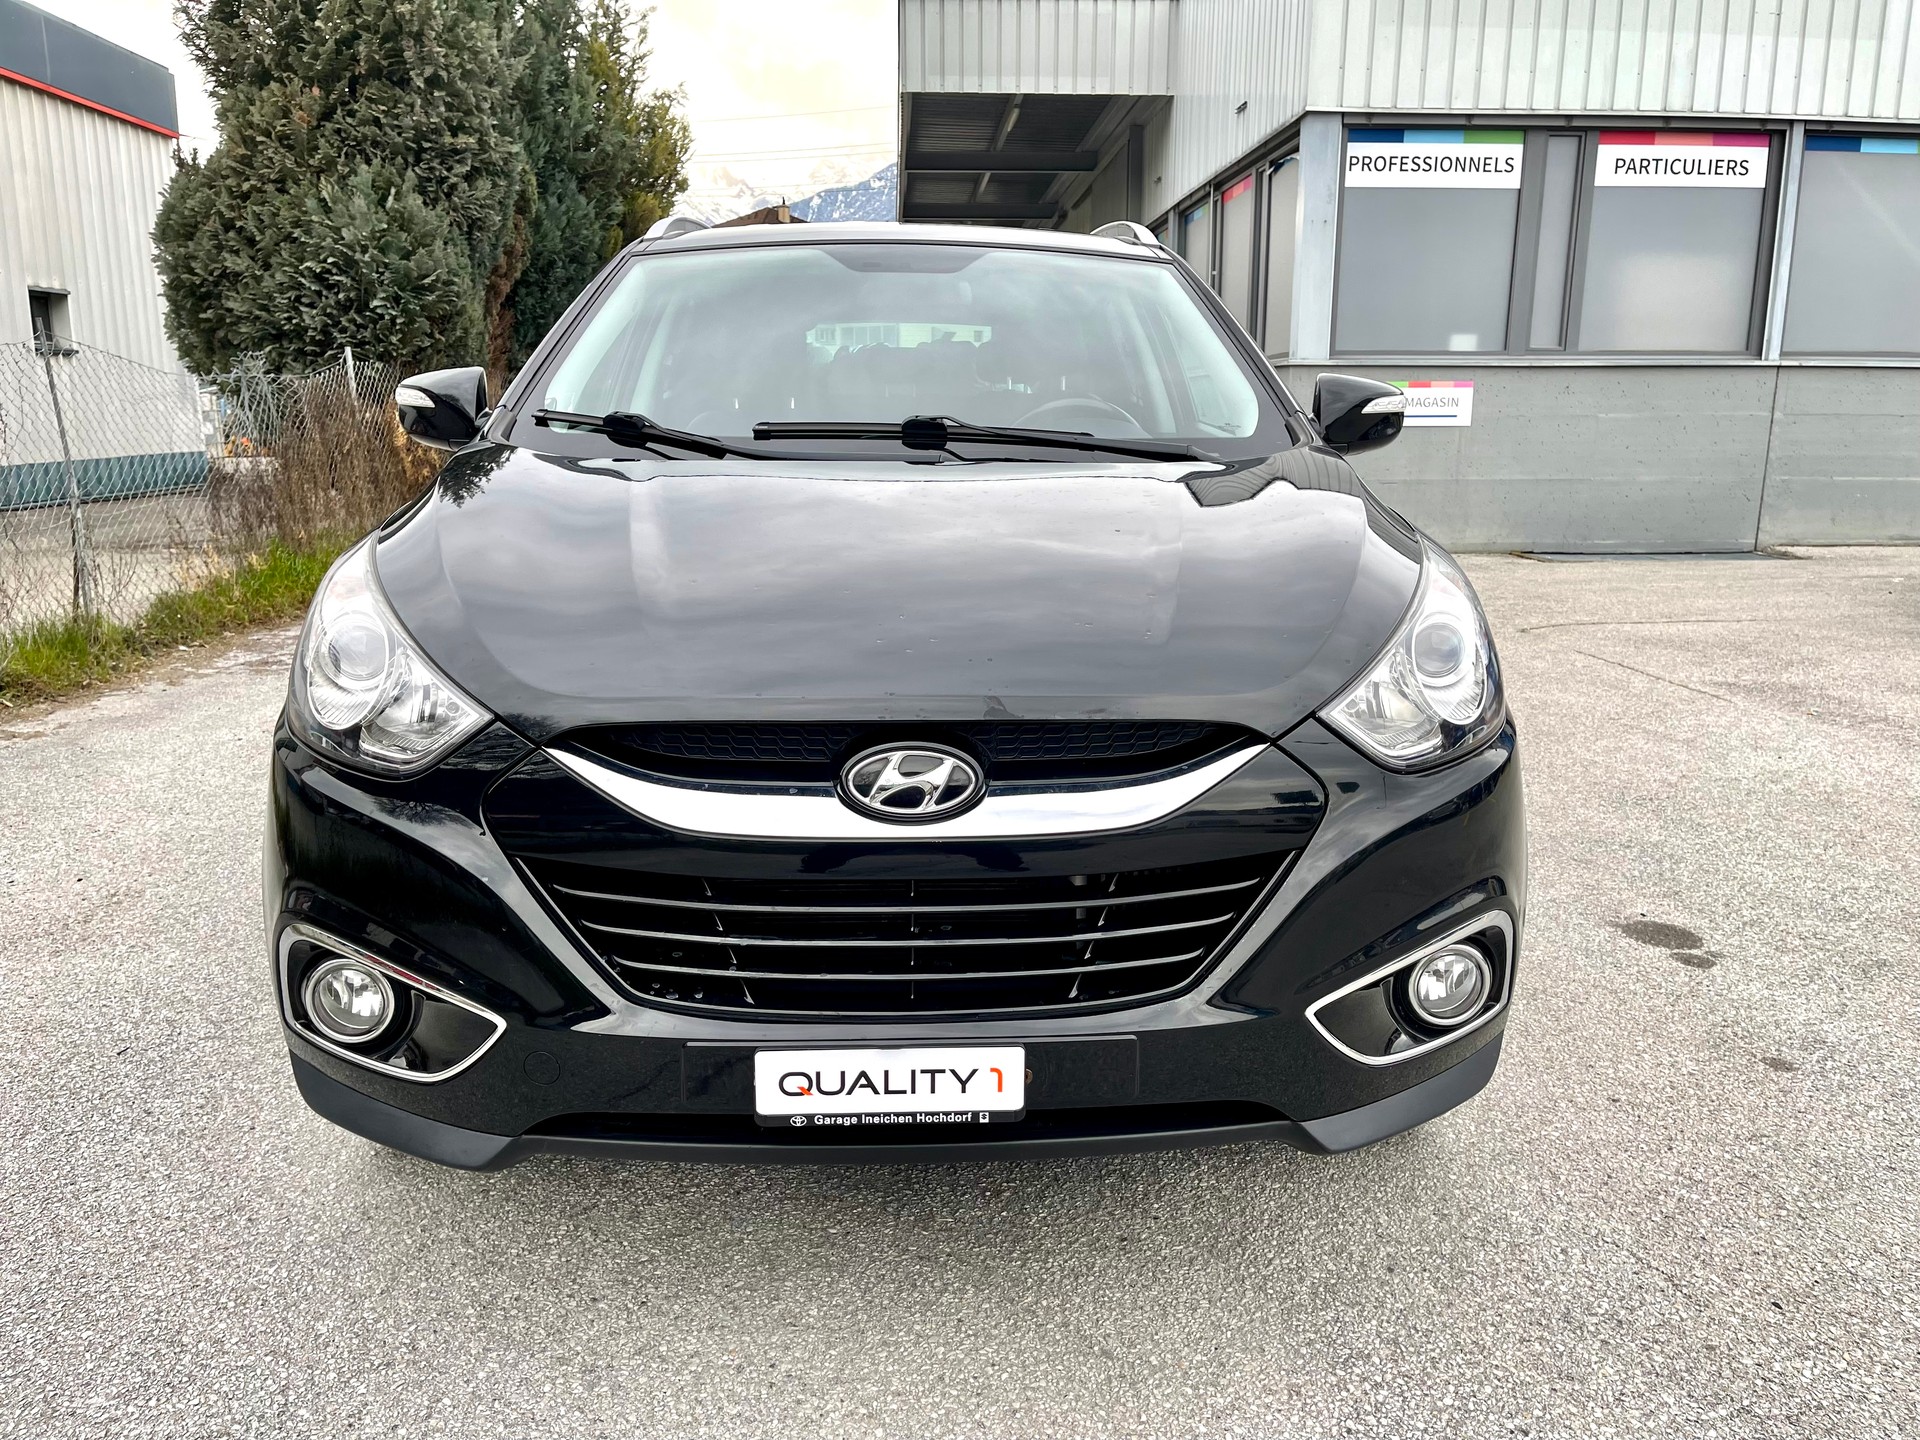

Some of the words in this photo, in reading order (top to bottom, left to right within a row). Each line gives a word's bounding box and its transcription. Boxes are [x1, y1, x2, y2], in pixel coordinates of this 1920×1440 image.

[1348, 155, 1515, 173] PROFESSIONNELS
[1614, 157, 1750, 176] PARTICULIERS
[1405, 397, 1460, 408] MAGASIN
[778, 1068, 979, 1097] QUALITY
[989, 1067, 1004, 1093] 1
[814, 1115, 859, 1126] Garage
[861, 1113, 913, 1124] Ineichen
[916, 1112, 972, 1123] Hochdorf
